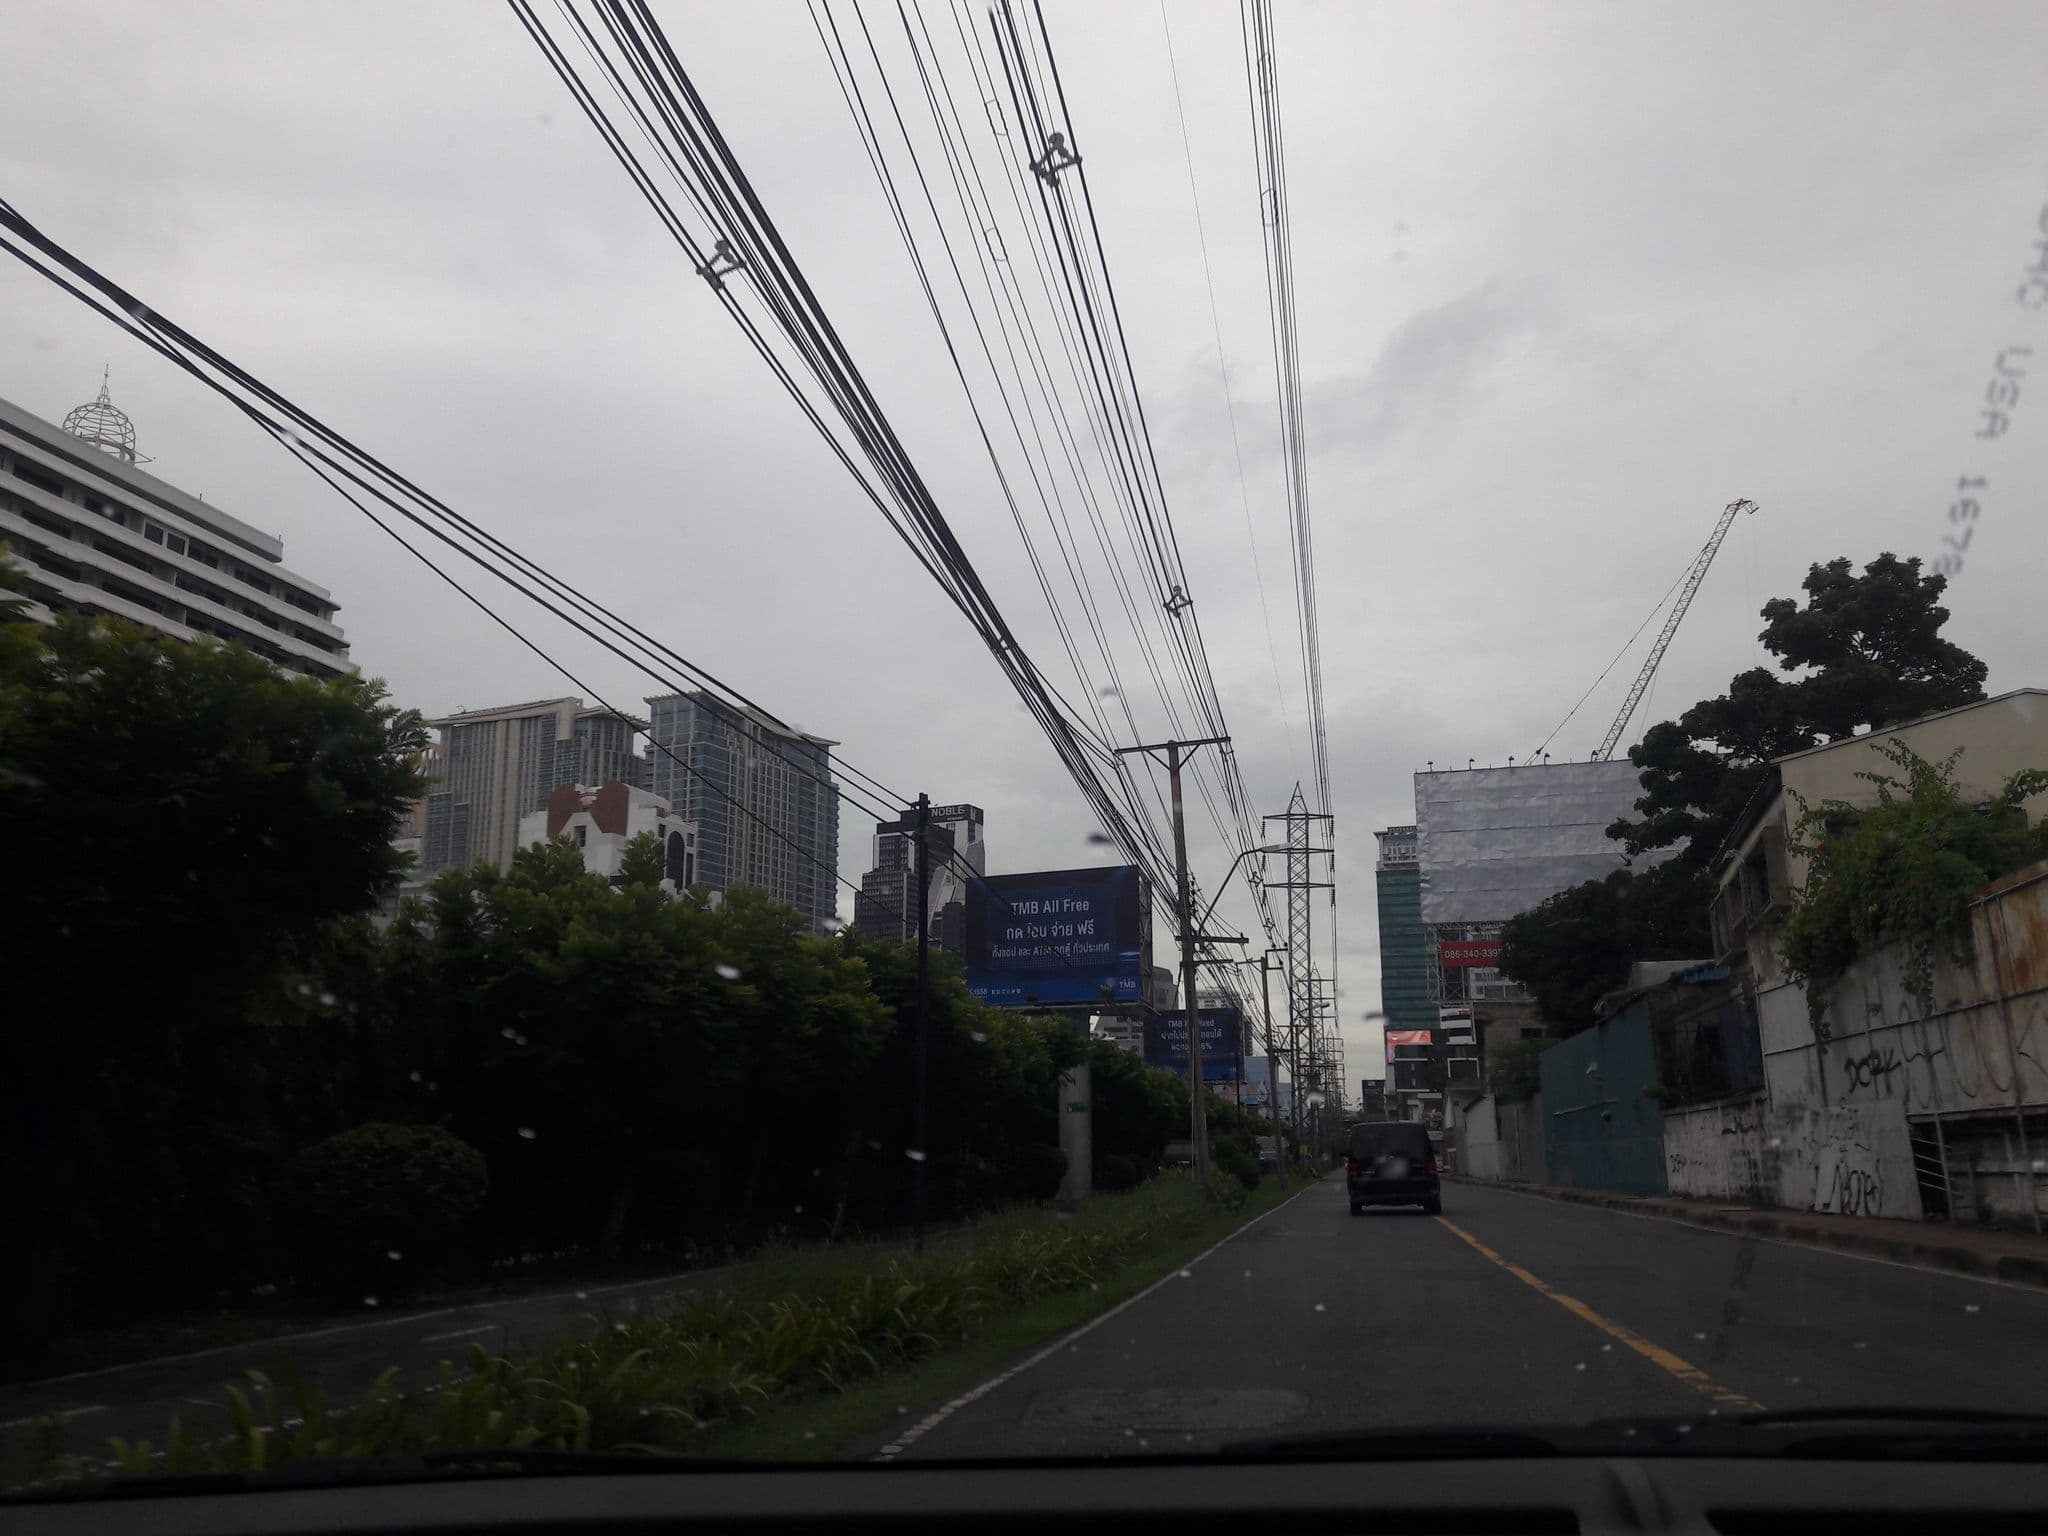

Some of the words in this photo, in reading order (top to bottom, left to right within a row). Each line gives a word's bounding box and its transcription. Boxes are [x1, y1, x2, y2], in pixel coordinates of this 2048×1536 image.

[931, 806, 965, 817] NOBLE
[1011, 902, 1039, 916] TMB
[1043, 899, 1059, 913] All
[1063, 899, 1090, 912] Free
[1006, 927, 1023, 940] กด
[1051, 921, 1073, 937] จ่าย
[1077, 918, 1095, 936] ฟรี
[1119, 978, 1137, 989] TMB
